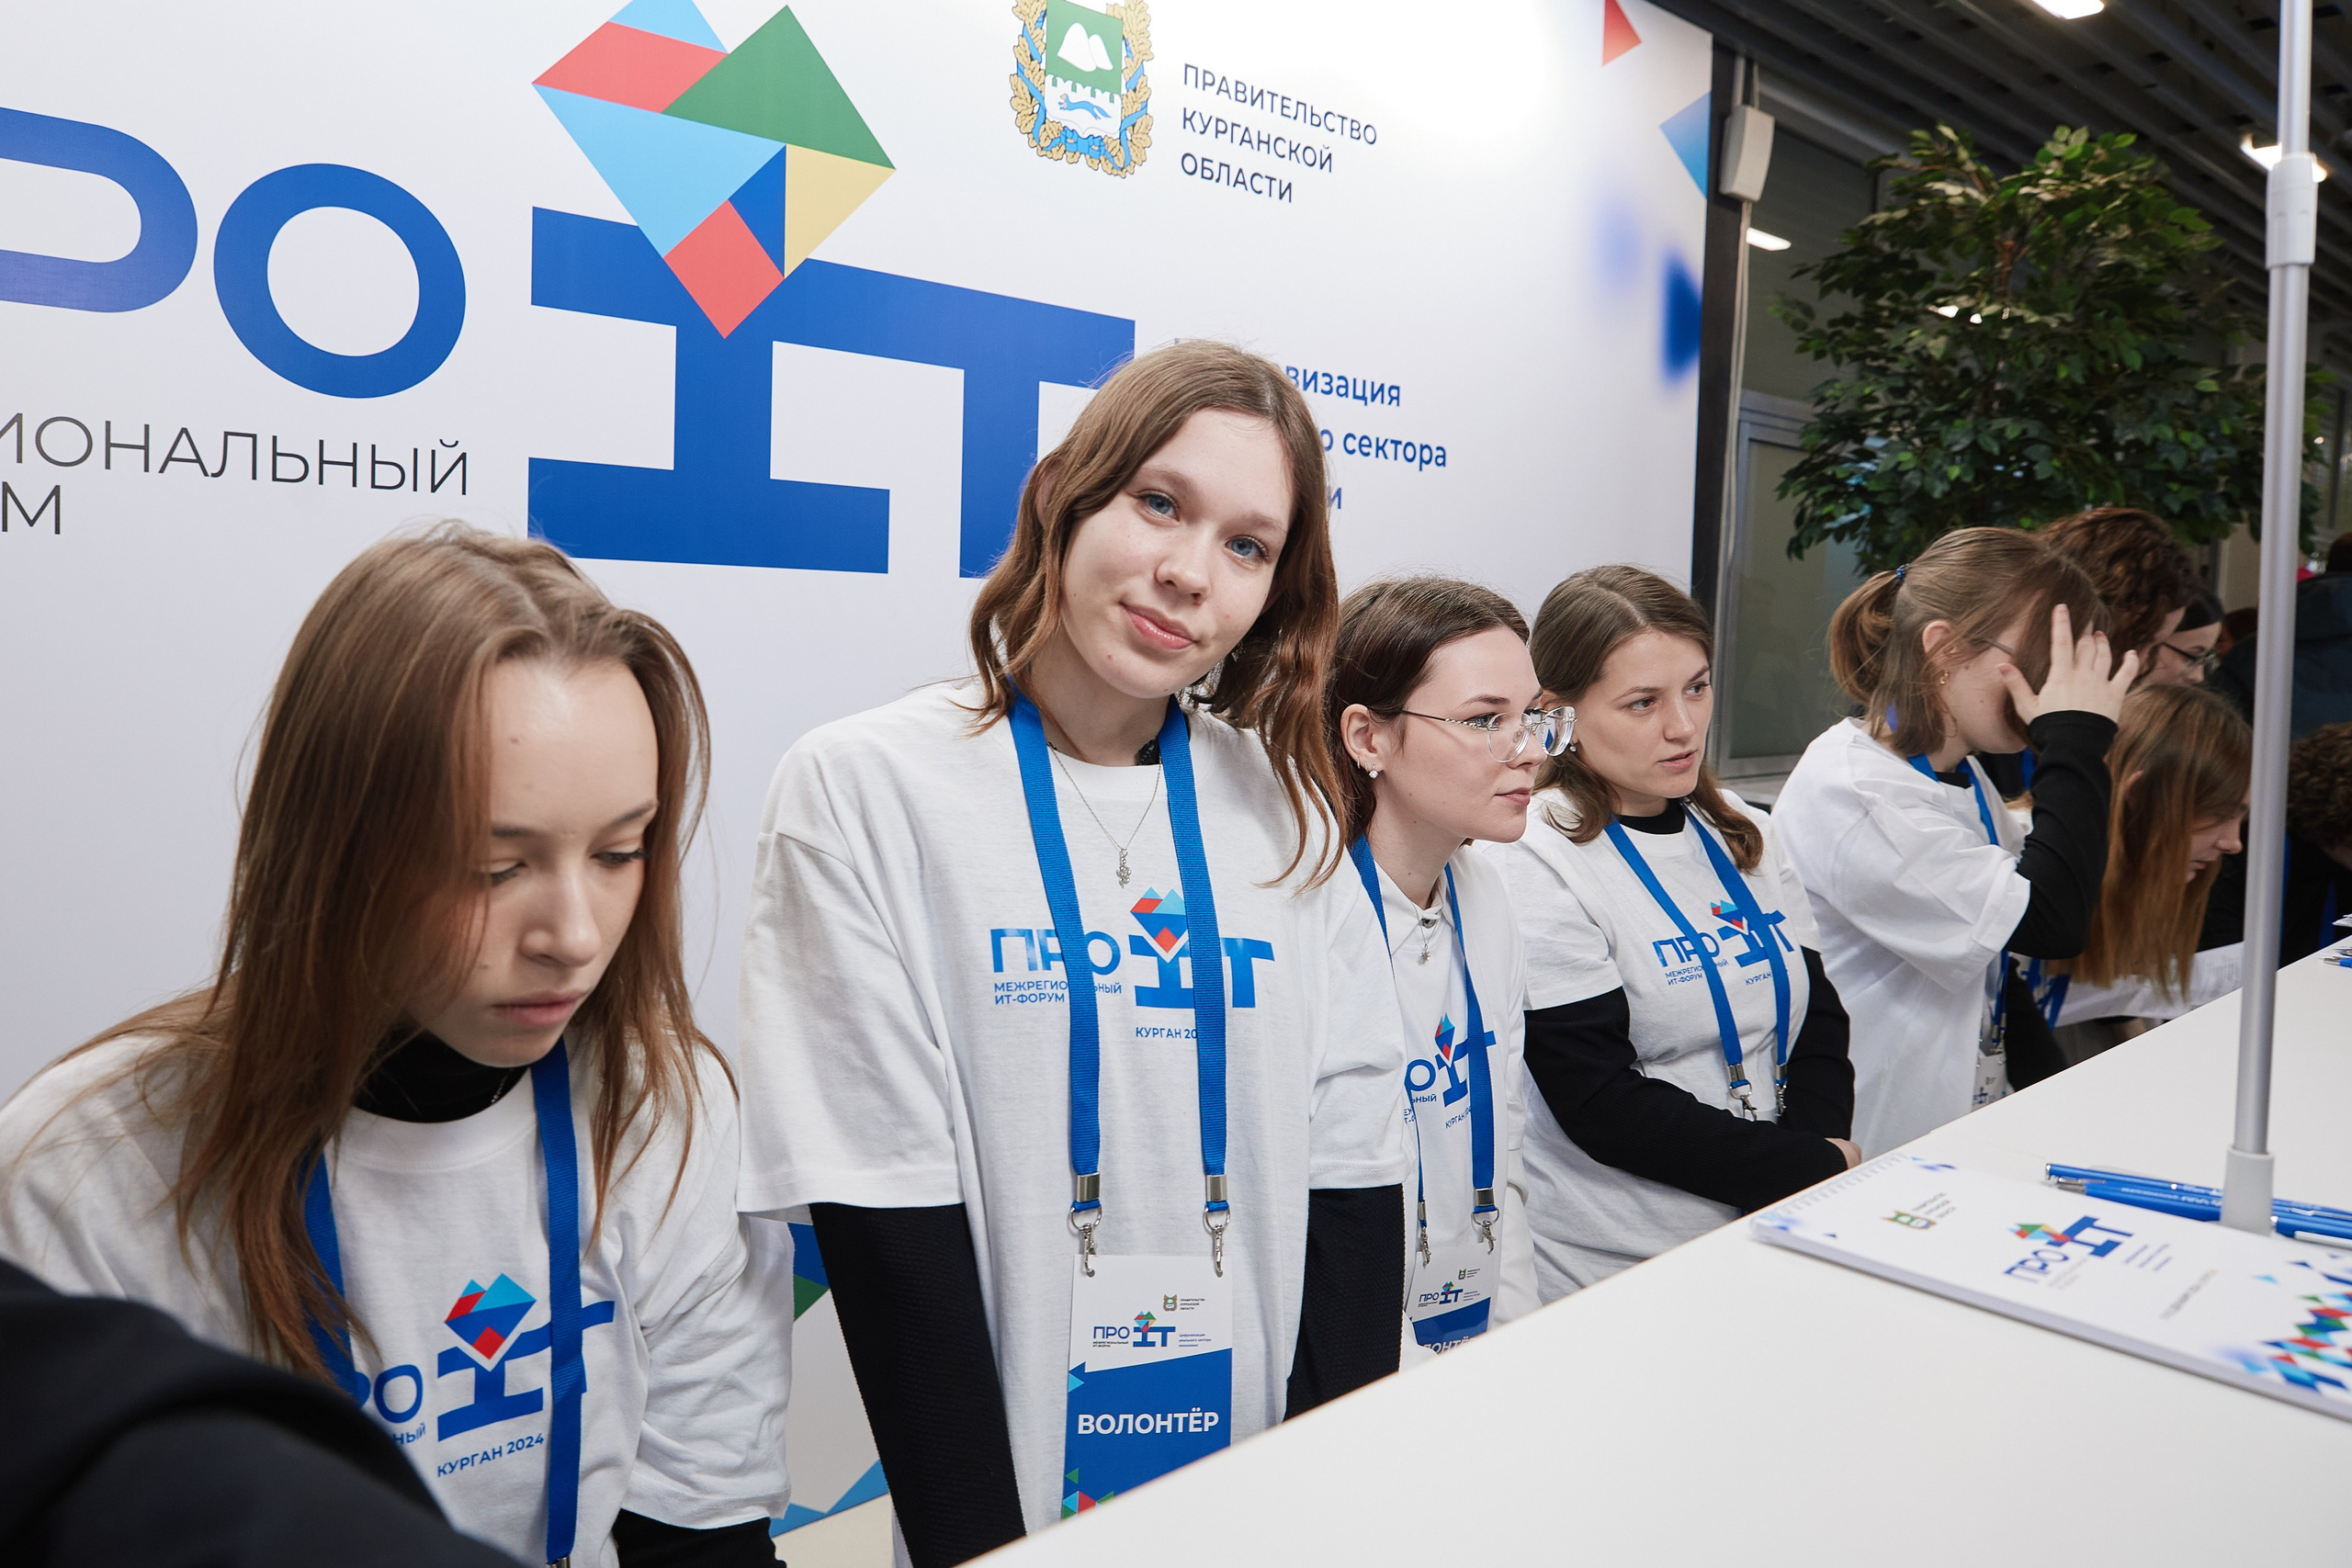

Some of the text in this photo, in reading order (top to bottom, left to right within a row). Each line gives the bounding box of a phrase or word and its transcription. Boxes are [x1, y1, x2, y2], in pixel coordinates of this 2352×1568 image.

[1183, 62, 1377, 145] ПРАВИТЕЛЬСТВО
[1182, 107, 1333, 174] КУРГАНСКОЙ
[1181, 152, 1293, 204] ОБЛАСТИ
[1285, 366, 1401, 407] визация
[1342, 432, 1447, 472] сектора
[990, 928, 1122, 976] ПРО
[993, 979, 1123, 995] МЕЖРЕГИОНЫЙ
[1745, 971, 1772, 986] КУРГАН
[994, 993, 1066, 1006] ИТ-ФОРУМ
[1135, 1026, 1198, 1040] КУРГАН 20
[1419, 1292, 1440, 1303] ПРО
[1092, 1325, 1176, 1348] ПРО IT
[1077, 1406, 1220, 1435] ВОЛОНТЁР
[437, 1432, 546, 1478] КУРГАН 2024
